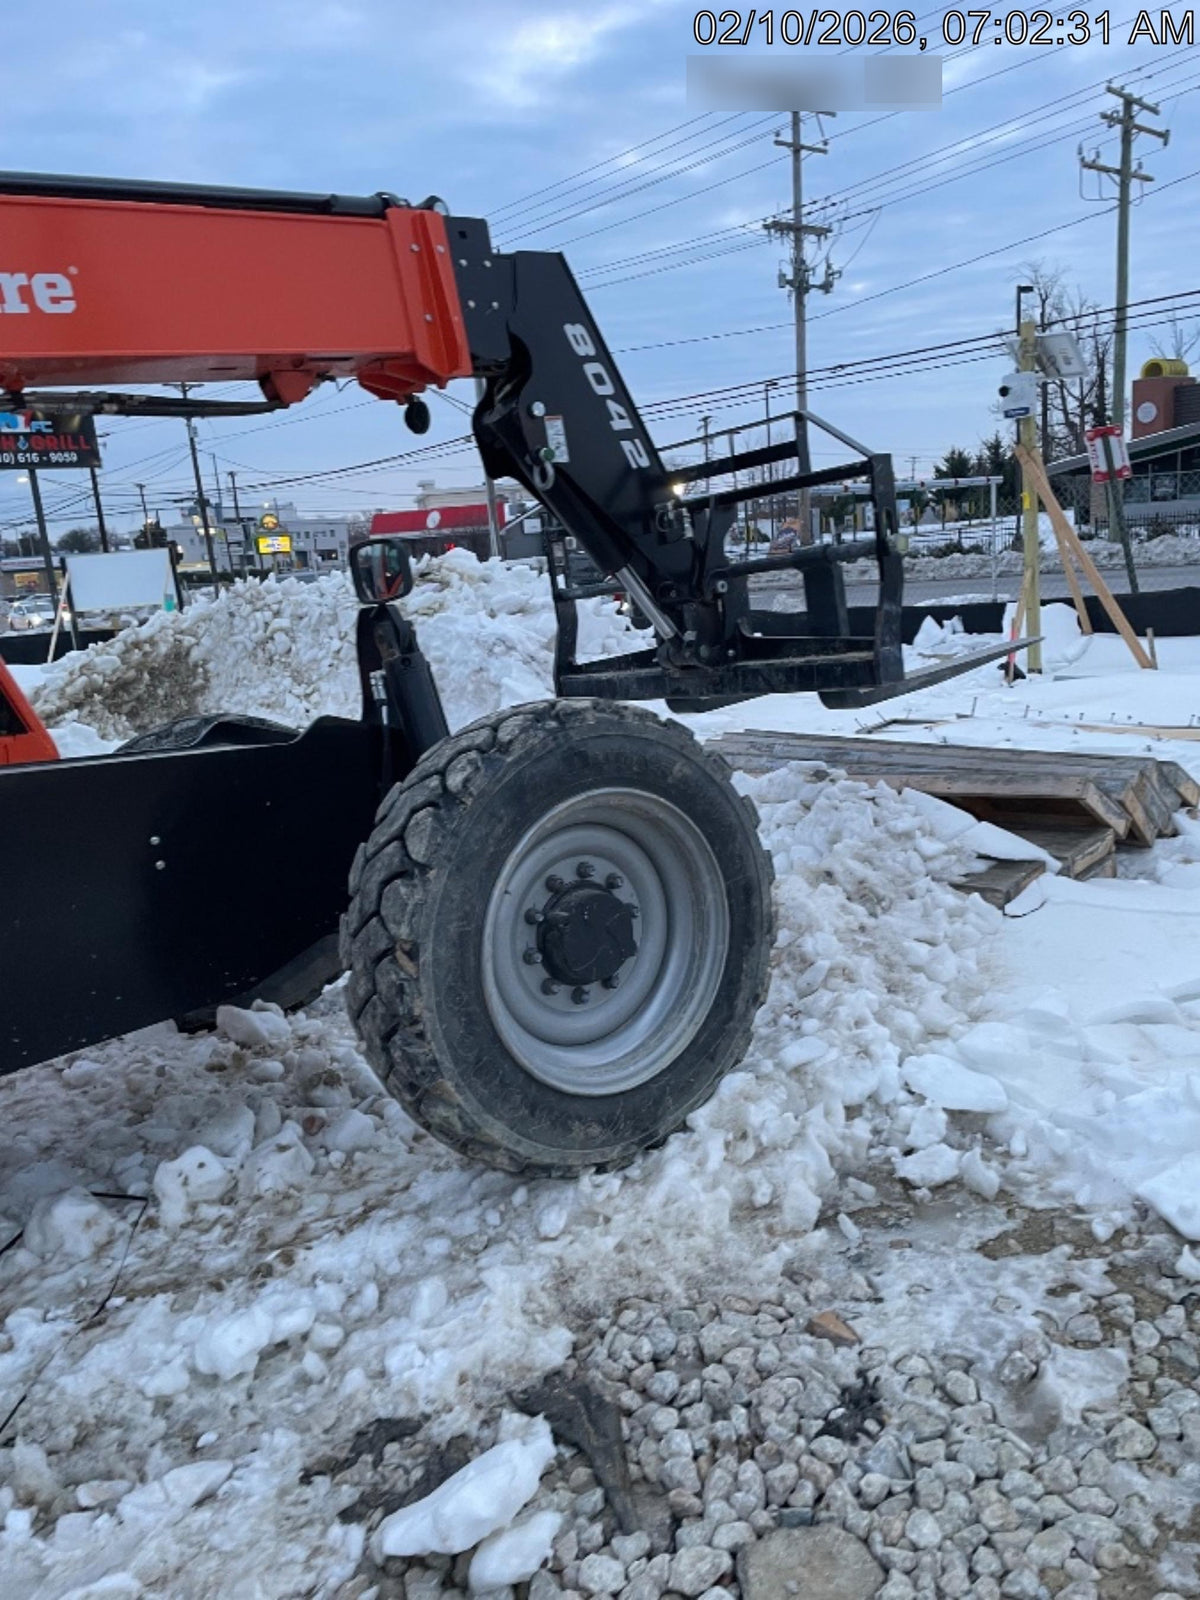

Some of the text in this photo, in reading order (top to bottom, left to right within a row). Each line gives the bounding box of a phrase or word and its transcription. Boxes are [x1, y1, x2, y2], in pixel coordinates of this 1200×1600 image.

[563, 323, 650, 469] 8042
[30, 434, 91, 450] GRILL
[17, 452, 40, 463] 616
